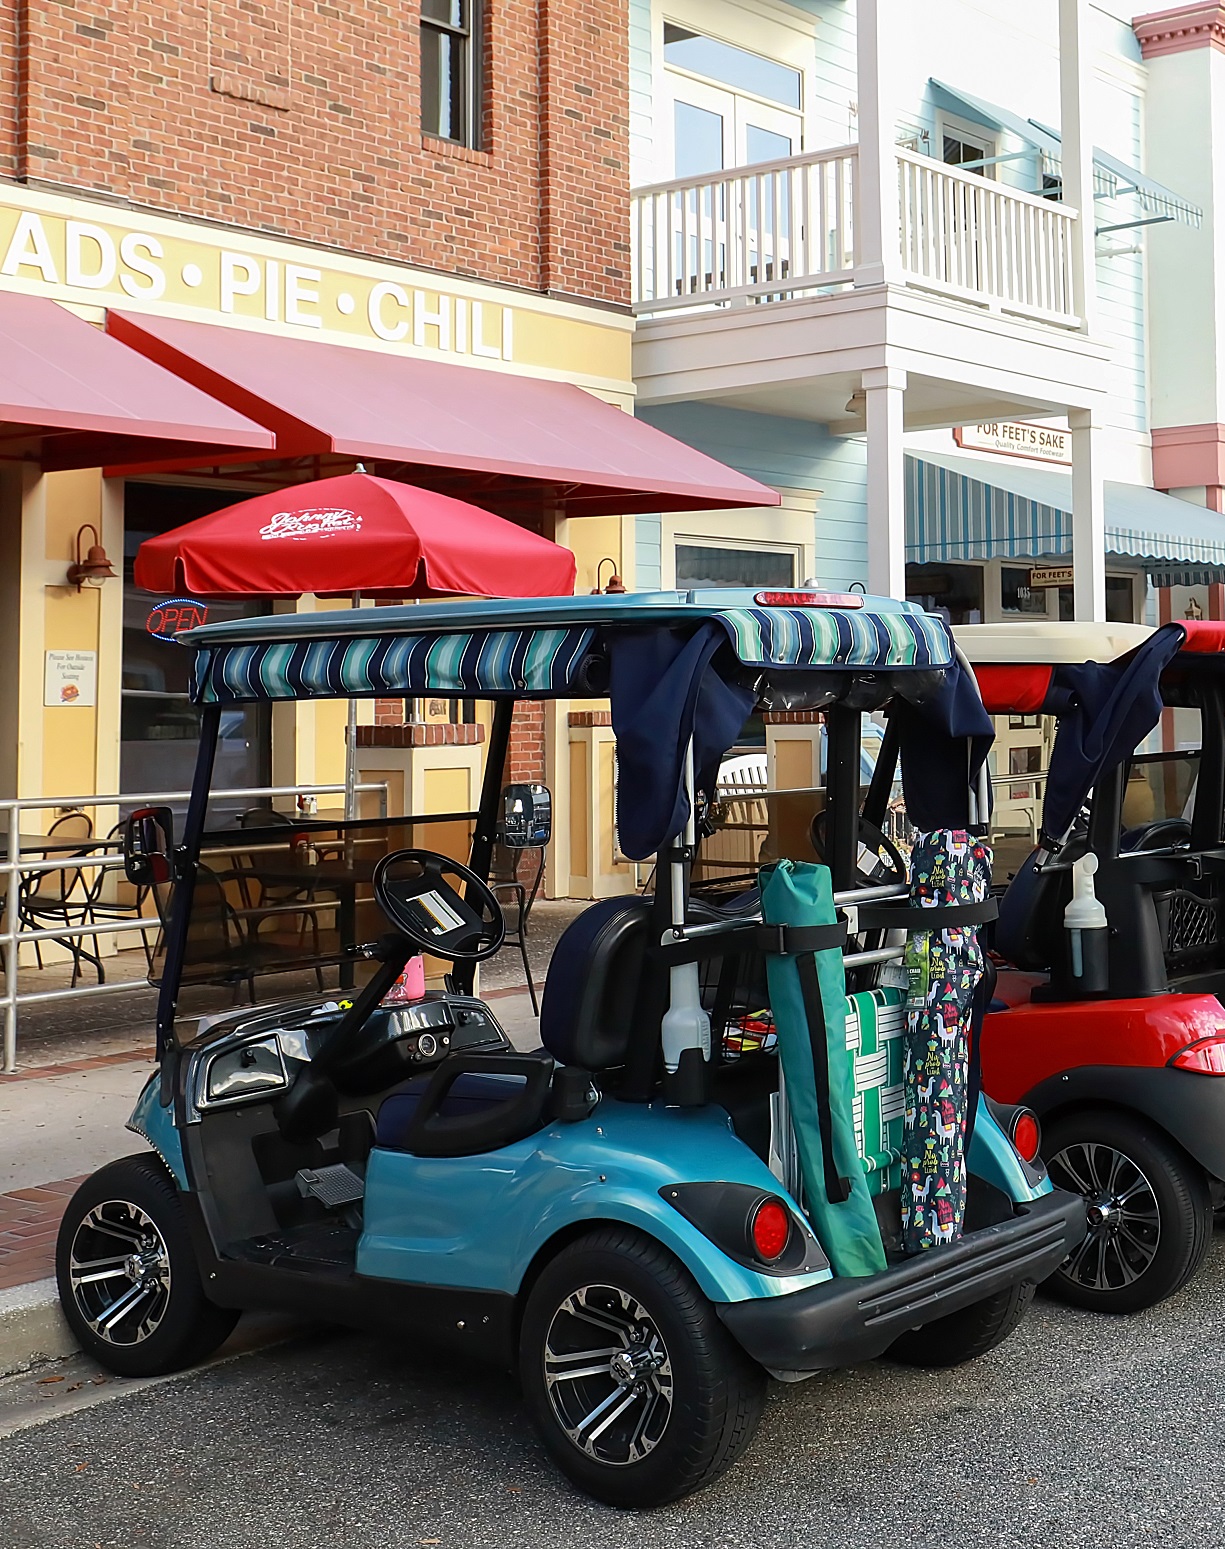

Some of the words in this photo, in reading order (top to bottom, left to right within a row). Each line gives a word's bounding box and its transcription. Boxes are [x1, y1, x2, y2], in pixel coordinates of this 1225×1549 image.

[0, 211, 167, 300] ADS
[219, 250, 322, 329] PIE
[366, 281, 514, 361] CHILI
[976, 423, 999, 437] FOR
[1002, 425, 1037, 444] FEET'S
[1039, 432, 1065, 449] SAKE
[994, 439, 1015, 451] Quality
[1016, 443, 1039, 454] Comfort
[1039, 448, 1065, 458] Footwear
[1032, 572, 1047, 580] FOR
[1016, 586, 1031, 599] 1035
[145, 606, 209, 634] OPEN
